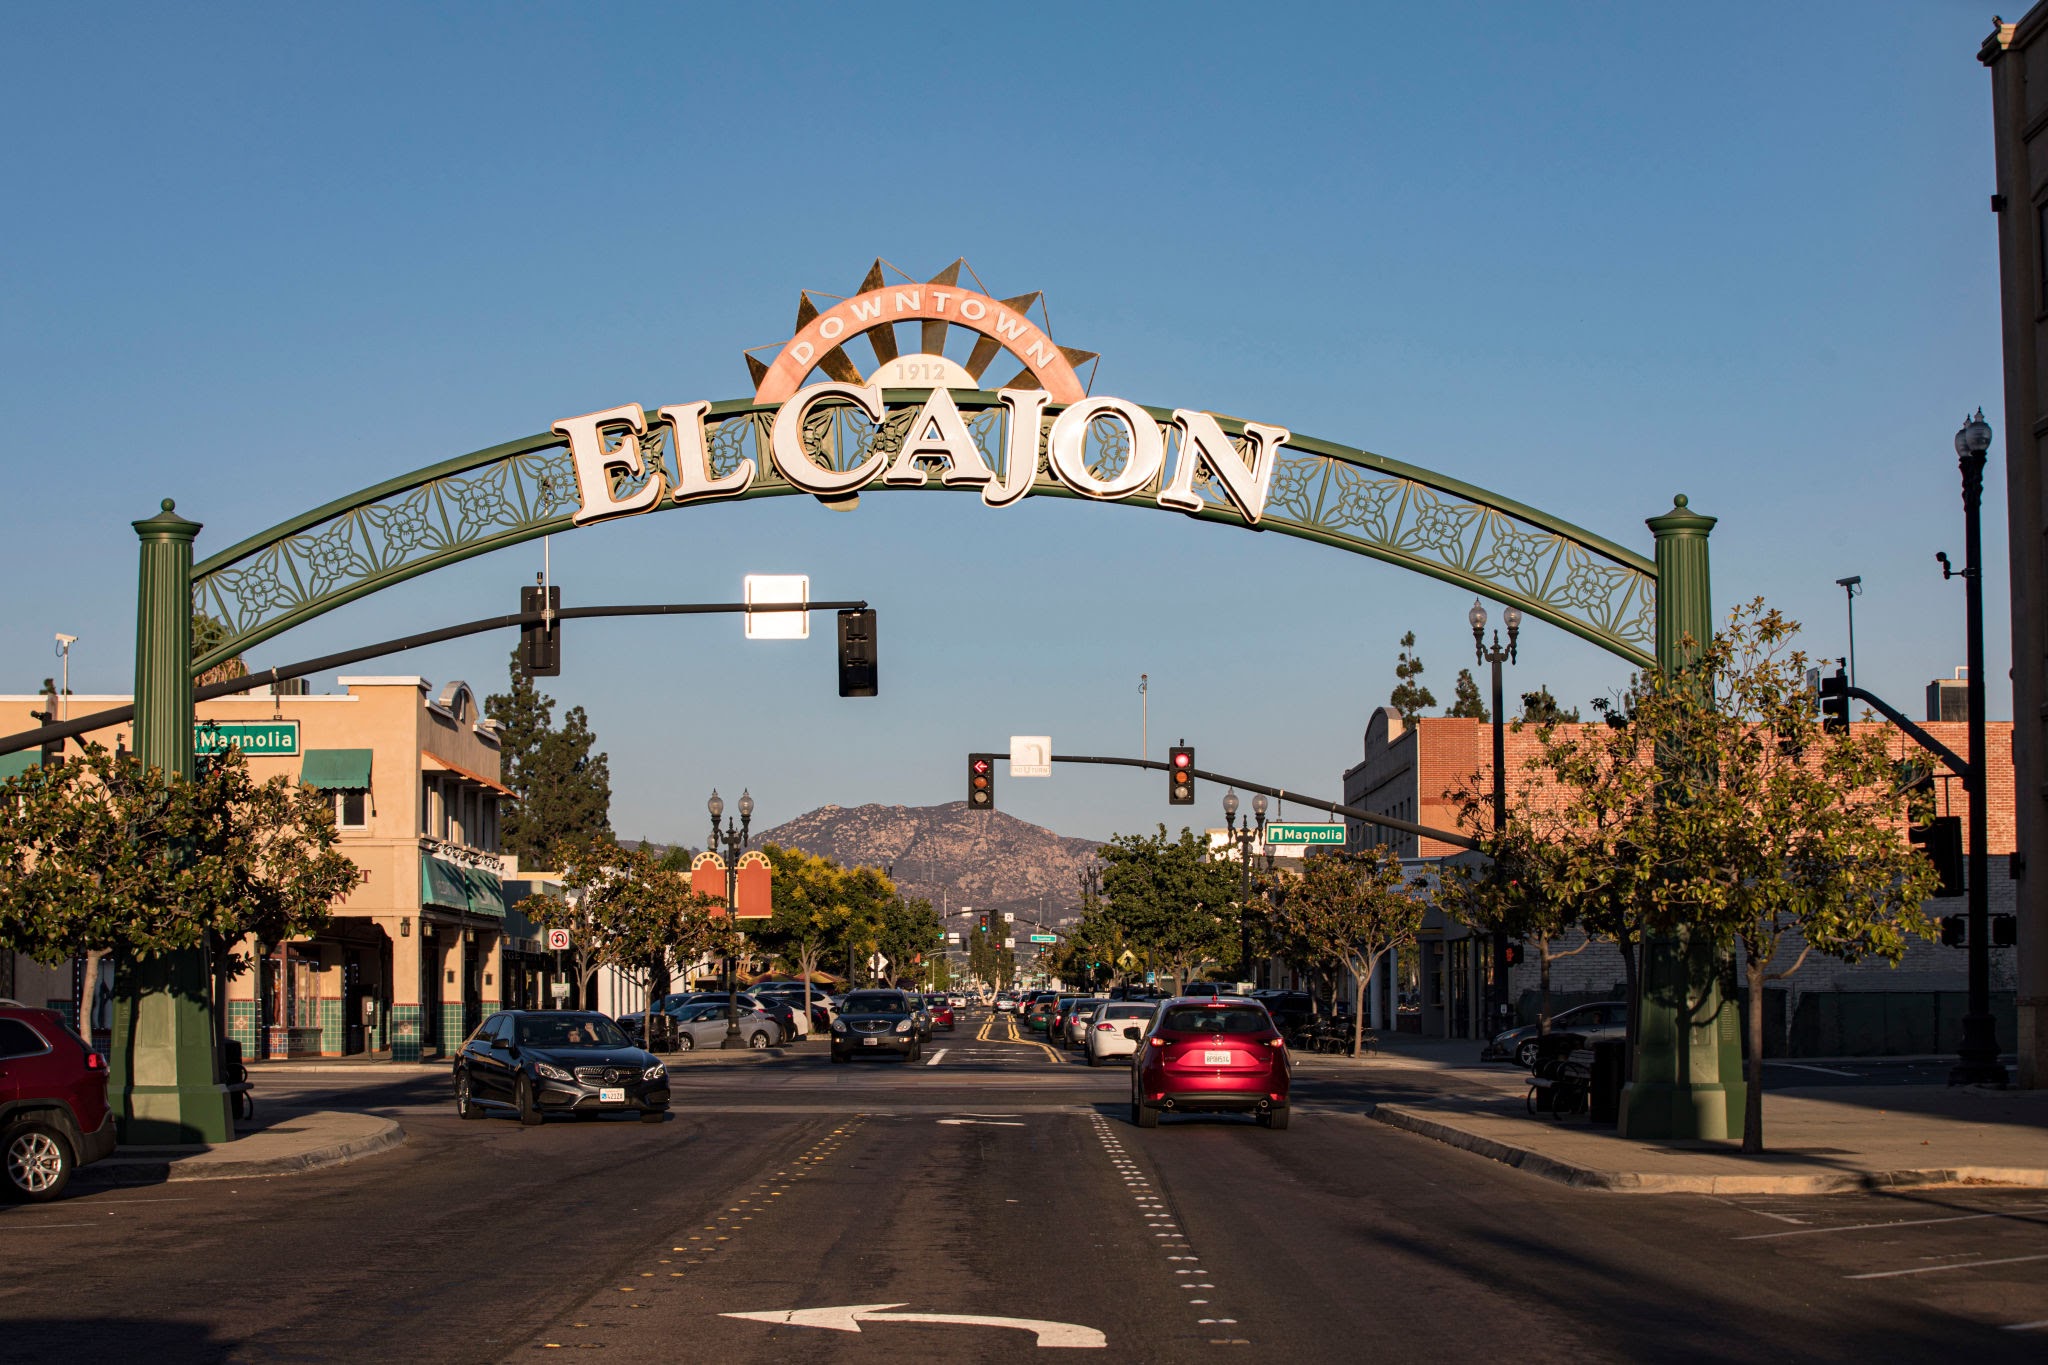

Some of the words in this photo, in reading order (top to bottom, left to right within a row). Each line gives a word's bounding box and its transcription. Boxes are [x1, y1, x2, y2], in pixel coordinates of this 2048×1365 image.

[789, 290, 1056, 369] DOWNTOWN
[896, 364, 945, 380] 1912
[551, 400, 756, 527] EL
[770, 382, 1290, 524] CAJON
[201, 731, 292, 749] Magnolia
[1285, 829, 1342, 843] Magnolia
